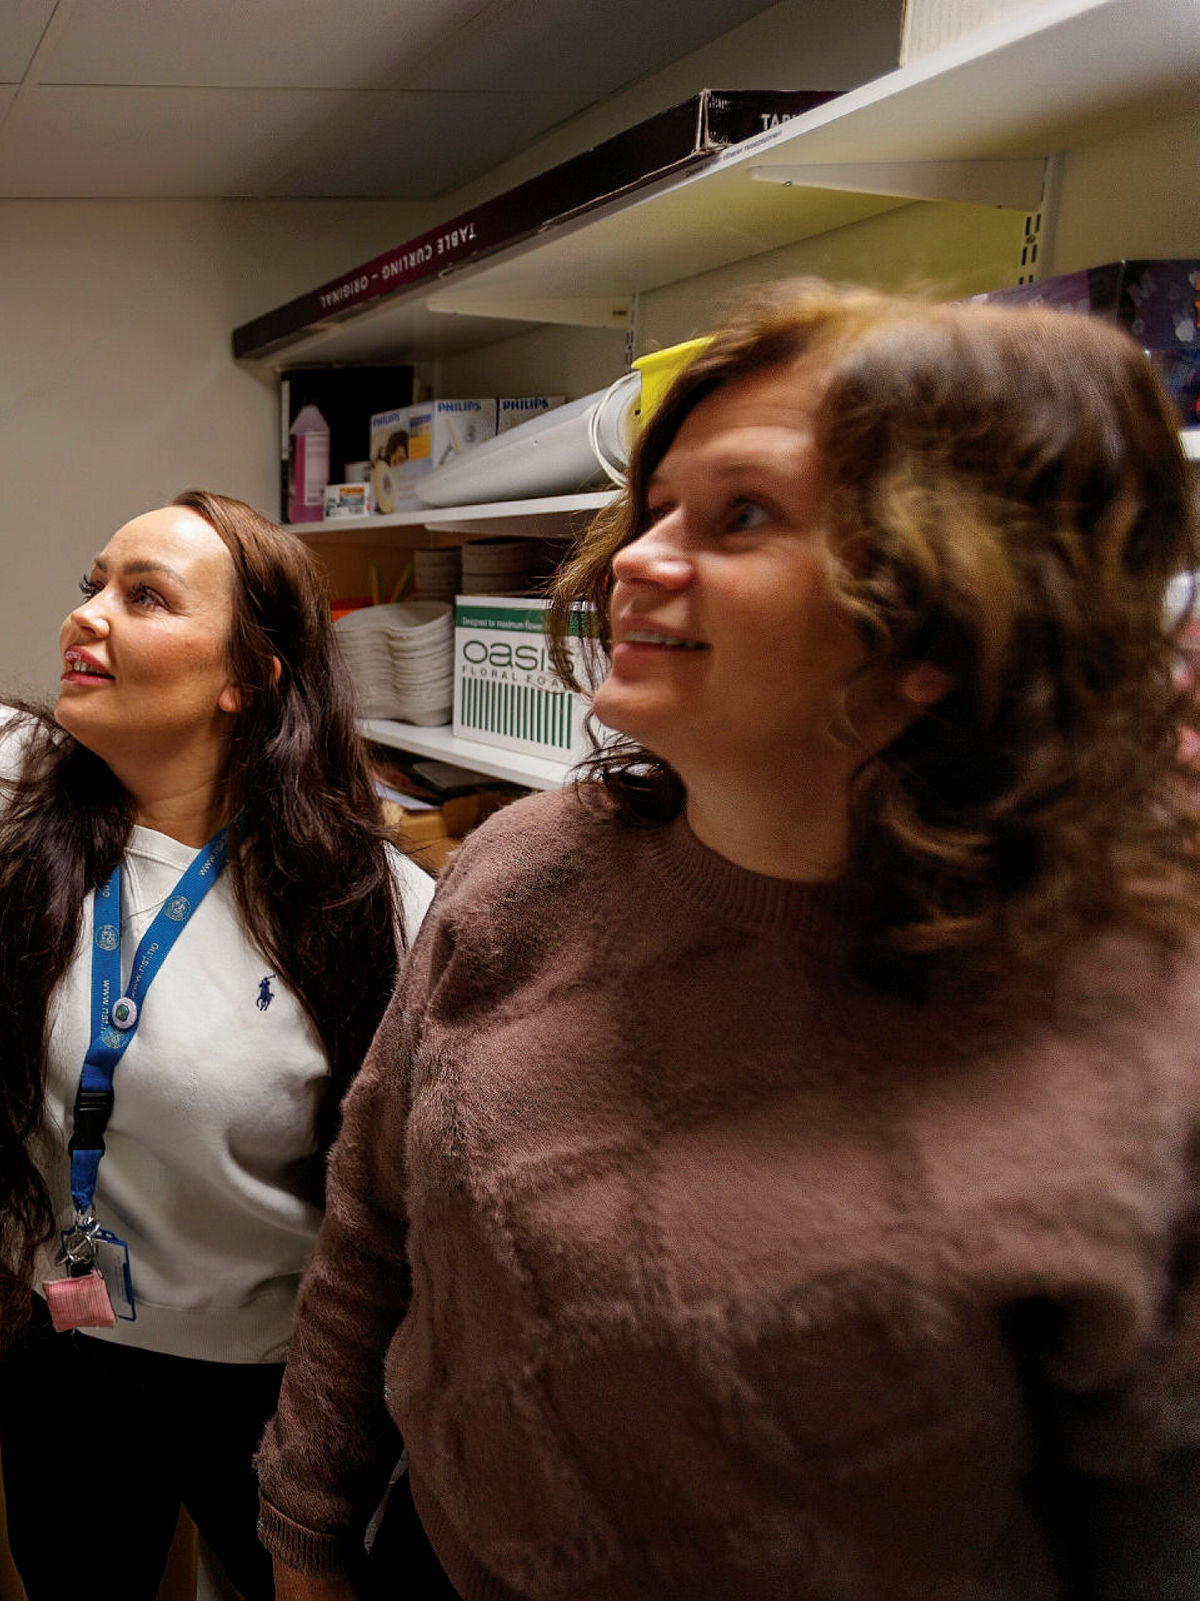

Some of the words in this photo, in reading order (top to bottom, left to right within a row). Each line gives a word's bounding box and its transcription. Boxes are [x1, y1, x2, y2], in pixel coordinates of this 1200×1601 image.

[437, 222, 477, 254] TABLE
[382, 244, 433, 280] CURLING
[320, 275, 369, 309] ORIGINAL
[437, 401, 481, 413] PHILIPS
[502, 399, 549, 411] PHILIPS
[374, 413, 400, 427] PHILIPS
[462, 666, 518, 681] FLORAL
[526, 676, 562, 688] FOA
[101, 979, 110, 1035] www.nsf.n
